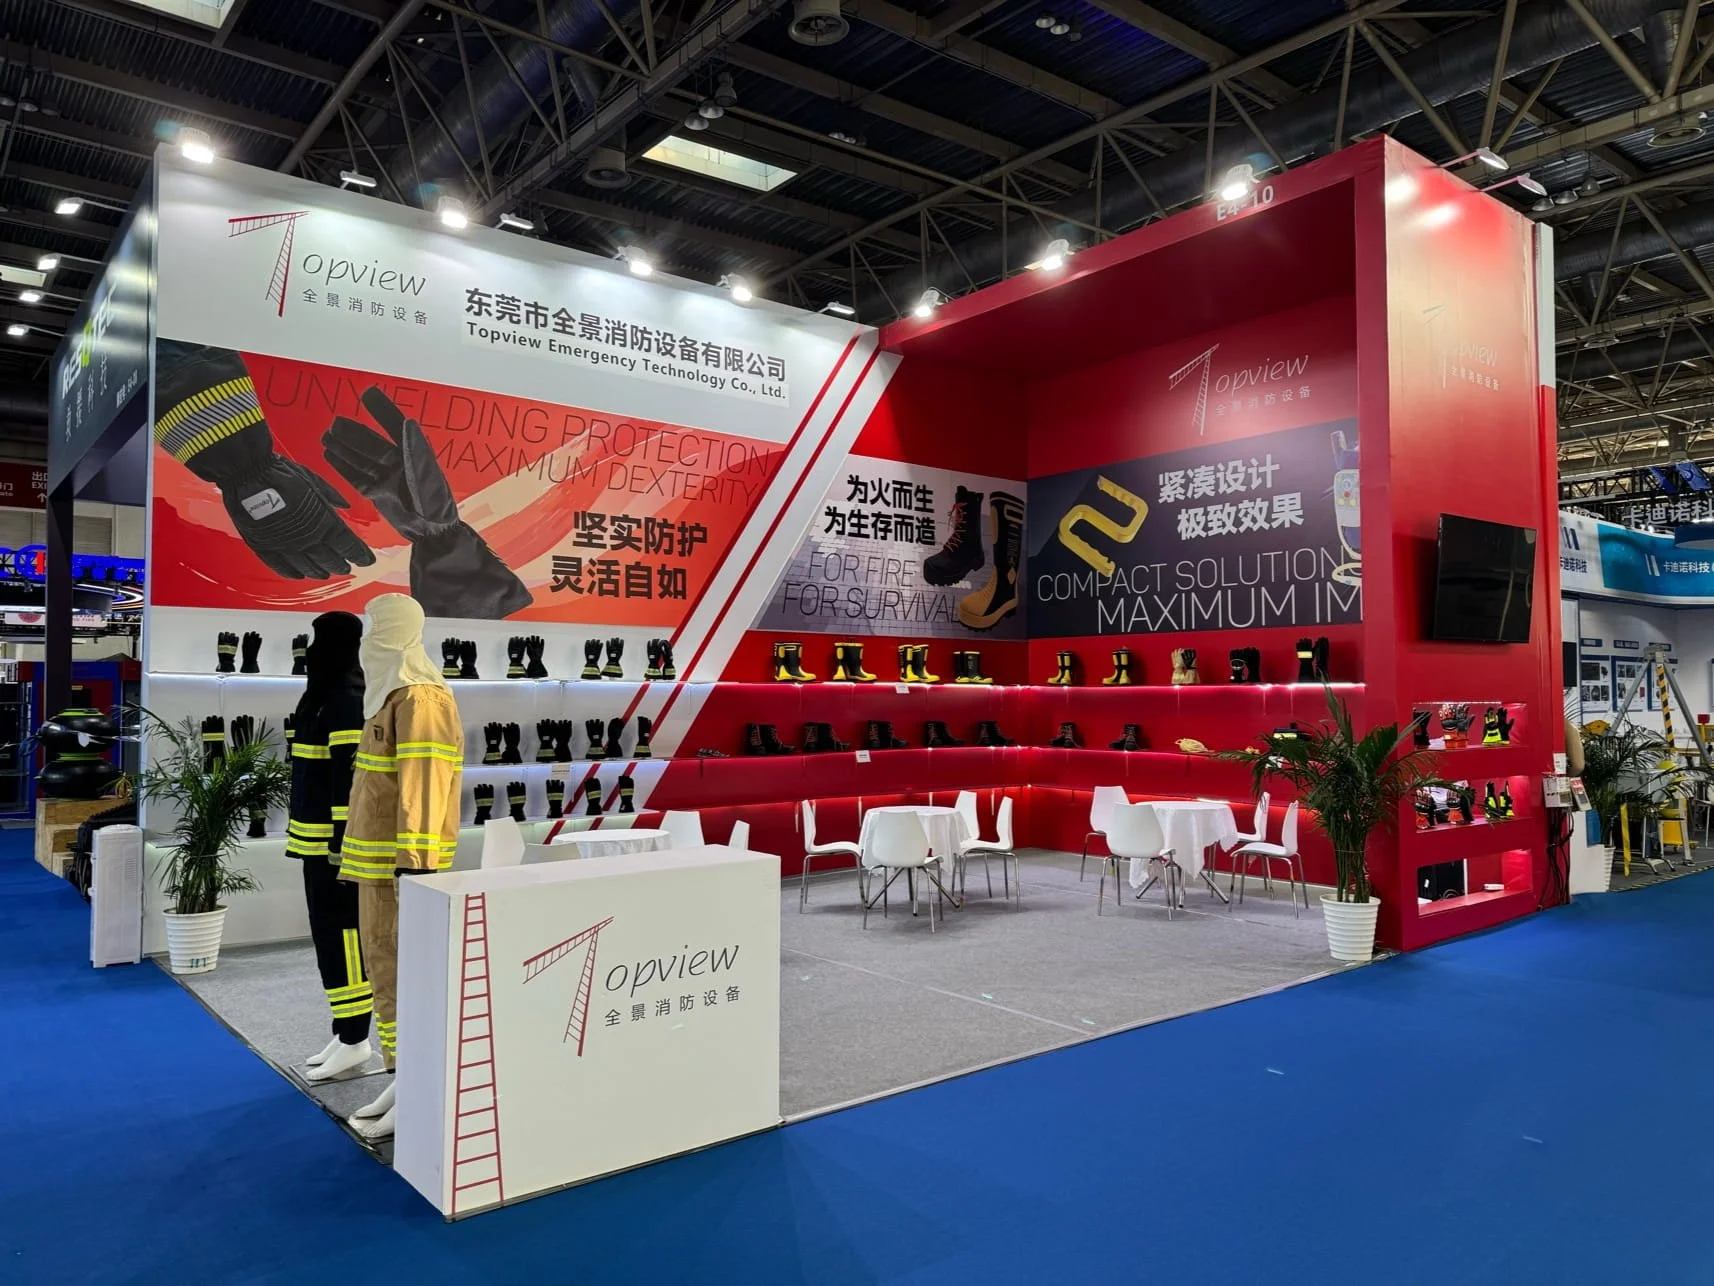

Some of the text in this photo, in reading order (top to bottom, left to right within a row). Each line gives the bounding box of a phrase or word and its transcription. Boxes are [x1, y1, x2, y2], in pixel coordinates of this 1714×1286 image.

[302, 288, 428, 325] 全景消防设备
[464, 287, 787, 382] 东莞市全景消防设备有限公司
[466, 321, 786, 400] Topview Emergency Technology Co., Ltd.
[265, 366, 770, 478] UNYELDING PROTECTION
[607, 462, 760, 507] DEXTERITY
[847, 474, 934, 513] 为火而生
[1157, 453, 1281, 504] 紧凑设计
[572, 510, 708, 558] 坚实防护
[824, 505, 936, 546] 为生存而造
[1177, 492, 1305, 542] 极致效果
[549, 555, 688, 600] 灵活自如
[807, 552, 917, 588] FOR FIRE
[1037, 546, 1362, 602] COMPACT SOLUTION
[782, 583, 838, 616] FOR
[1098, 583, 1297, 635] MAXIMUM
[605, 985, 741, 1027] 全景消防设备
